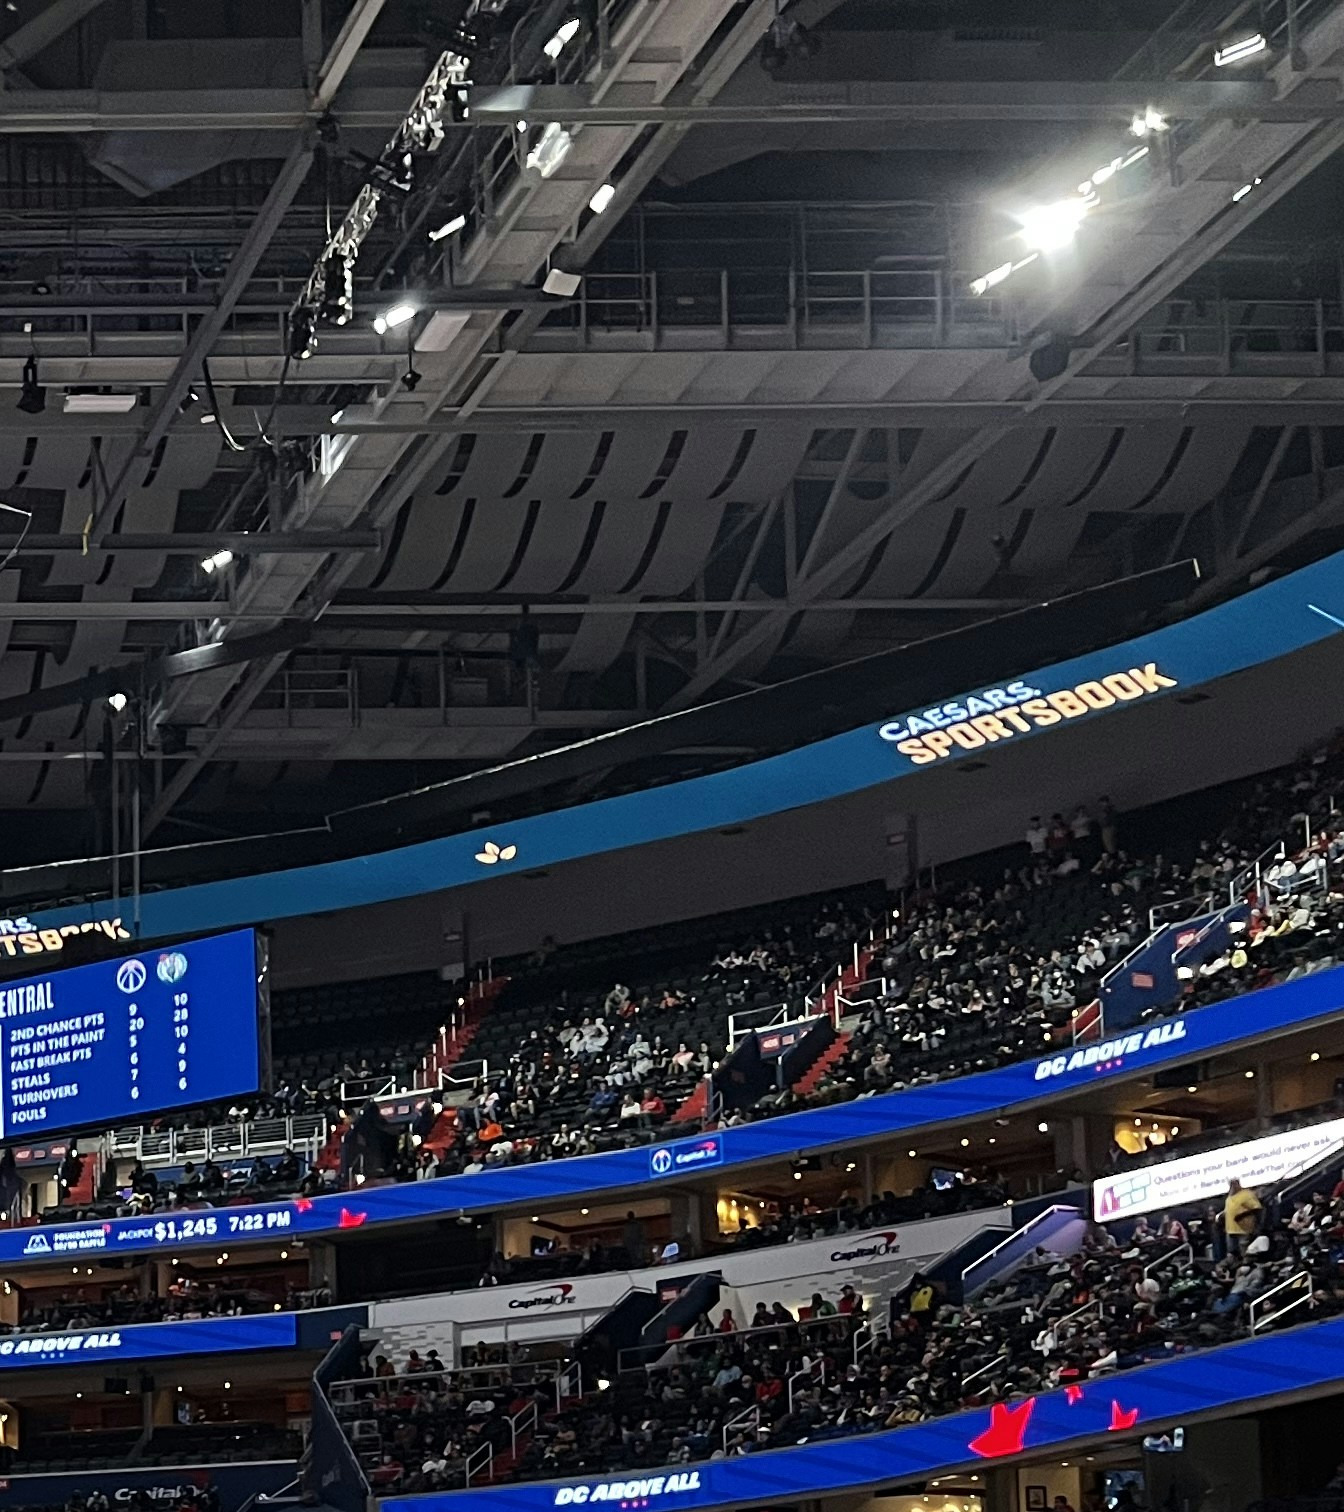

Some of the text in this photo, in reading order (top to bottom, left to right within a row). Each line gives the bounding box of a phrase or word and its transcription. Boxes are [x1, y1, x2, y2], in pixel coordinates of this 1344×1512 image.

[878, 679, 1043, 742] CAESARS
[896, 661, 1178, 765] SPORTSBOOK
[11, 1012, 105, 1043] 2ND CHANCE PTS
[11, 1029, 105, 1058] PTS IN THE PAINT
[1034, 1020, 1186, 1080] DC ABOVE ALL
[11, 1048, 92, 1073] FAST BREAK PTS
[11, 1073, 50, 1091] STEALS
[11, 1083, 78, 1107] TURNOVERS
[12, 1107, 47, 1124] FOULS
[154, 1211, 291, 1242] $1,245 7:22 PM
[15, 1336, 83, 1354] ABOVE
[83, 1333, 121, 1348] ALL
[554, 1471, 700, 1505] DC ABOVE ALL
